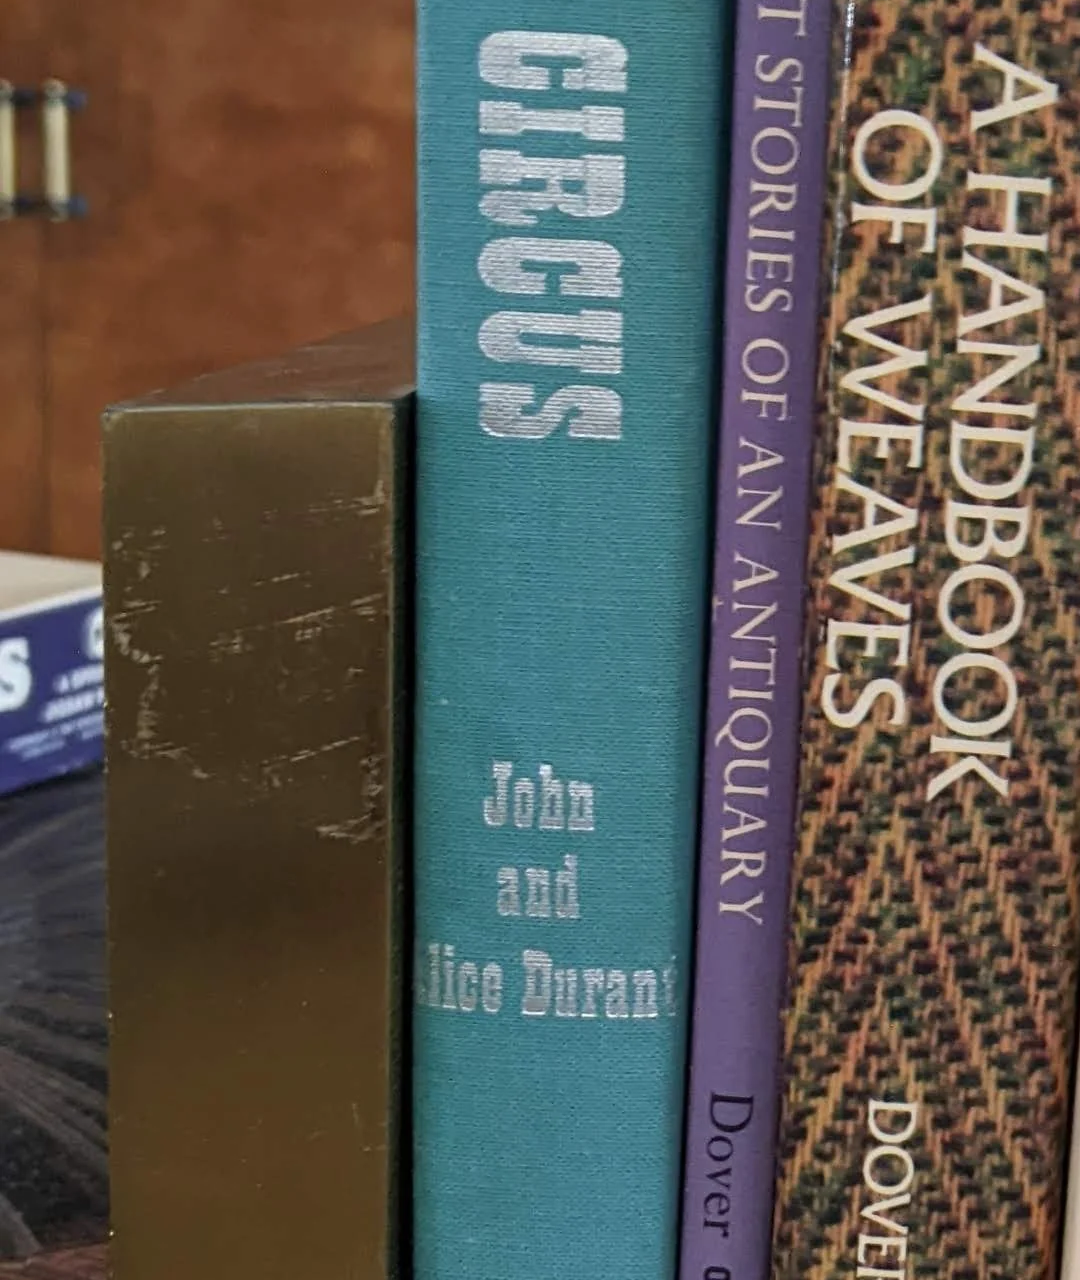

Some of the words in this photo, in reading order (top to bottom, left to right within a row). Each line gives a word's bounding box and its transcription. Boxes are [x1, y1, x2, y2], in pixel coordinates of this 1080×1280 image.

[970, 42, 1061, 130] A
[477, 30, 629, 441] CIRCUS
[744, 52, 805, 315] STORIES
[850, 107, 944, 256] OF
[740, 337, 791, 422] OF
[734, 435, 785, 531] AN
[820, 292, 934, 730] WEAVES
[926, 168, 1053, 802] HANDBOOK
[483, 760, 596, 831] John
[714, 551, 780, 926] ANTIQUARY
[496, 854, 582, 920] and
[416, 942, 504, 1014] lice
[701, 1091, 755, 1239] Dover
